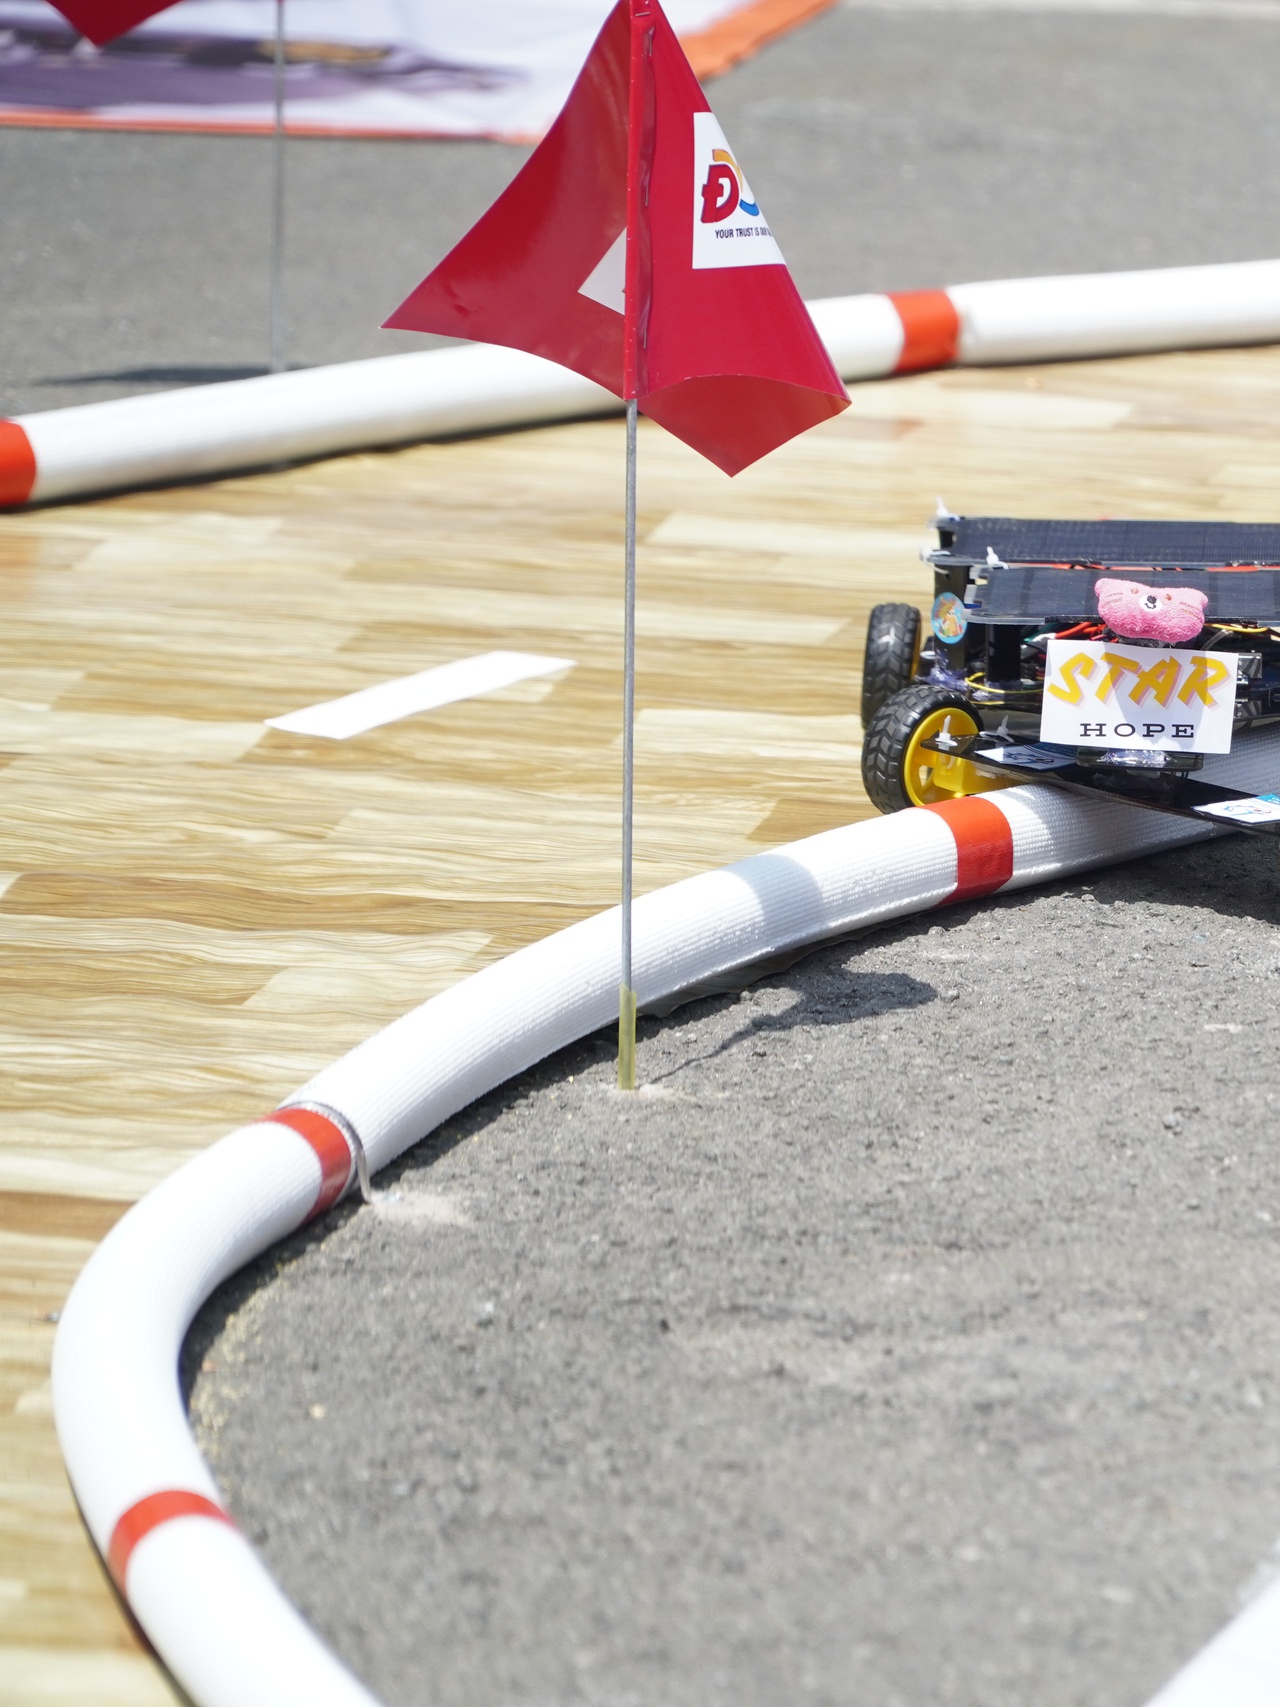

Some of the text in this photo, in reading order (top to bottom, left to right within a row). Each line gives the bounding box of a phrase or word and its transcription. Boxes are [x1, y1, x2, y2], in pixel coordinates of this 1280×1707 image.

[715, 229, 734, 239] YOUR
[735, 227, 753, 237] TRUST
[1047, 652, 1230, 710] STAR
[1080, 723, 1194, 738] HOPE
